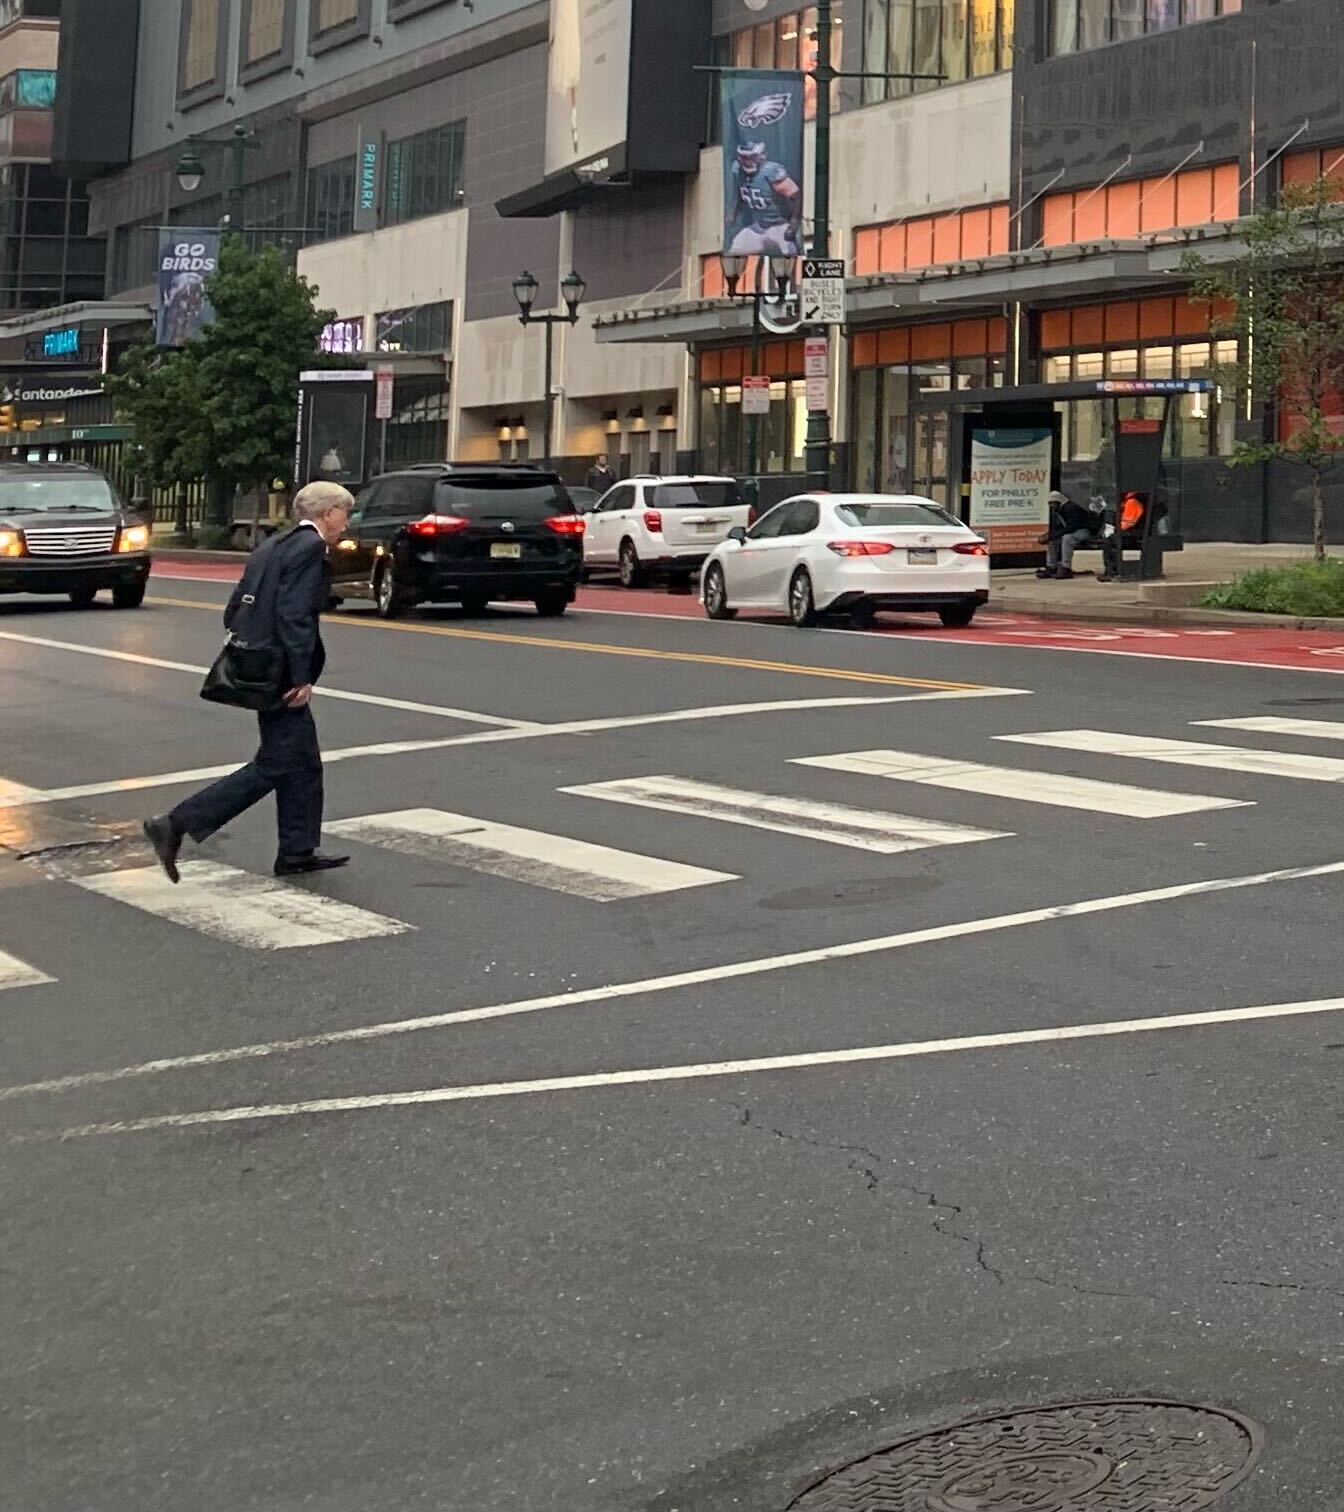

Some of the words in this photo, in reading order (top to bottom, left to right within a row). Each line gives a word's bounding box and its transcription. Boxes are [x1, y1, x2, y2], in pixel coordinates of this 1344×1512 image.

[361, 143, 376, 209] PRIMARK
[175, 243, 205, 257] GO
[162, 257, 216, 271] BIRDS
[972, 469, 1006, 485] APPLY
[981, 489, 1000, 498] FOR
[1001, 488, 1040, 498] PHILLY'S
[984, 499, 1006, 508] FREE
